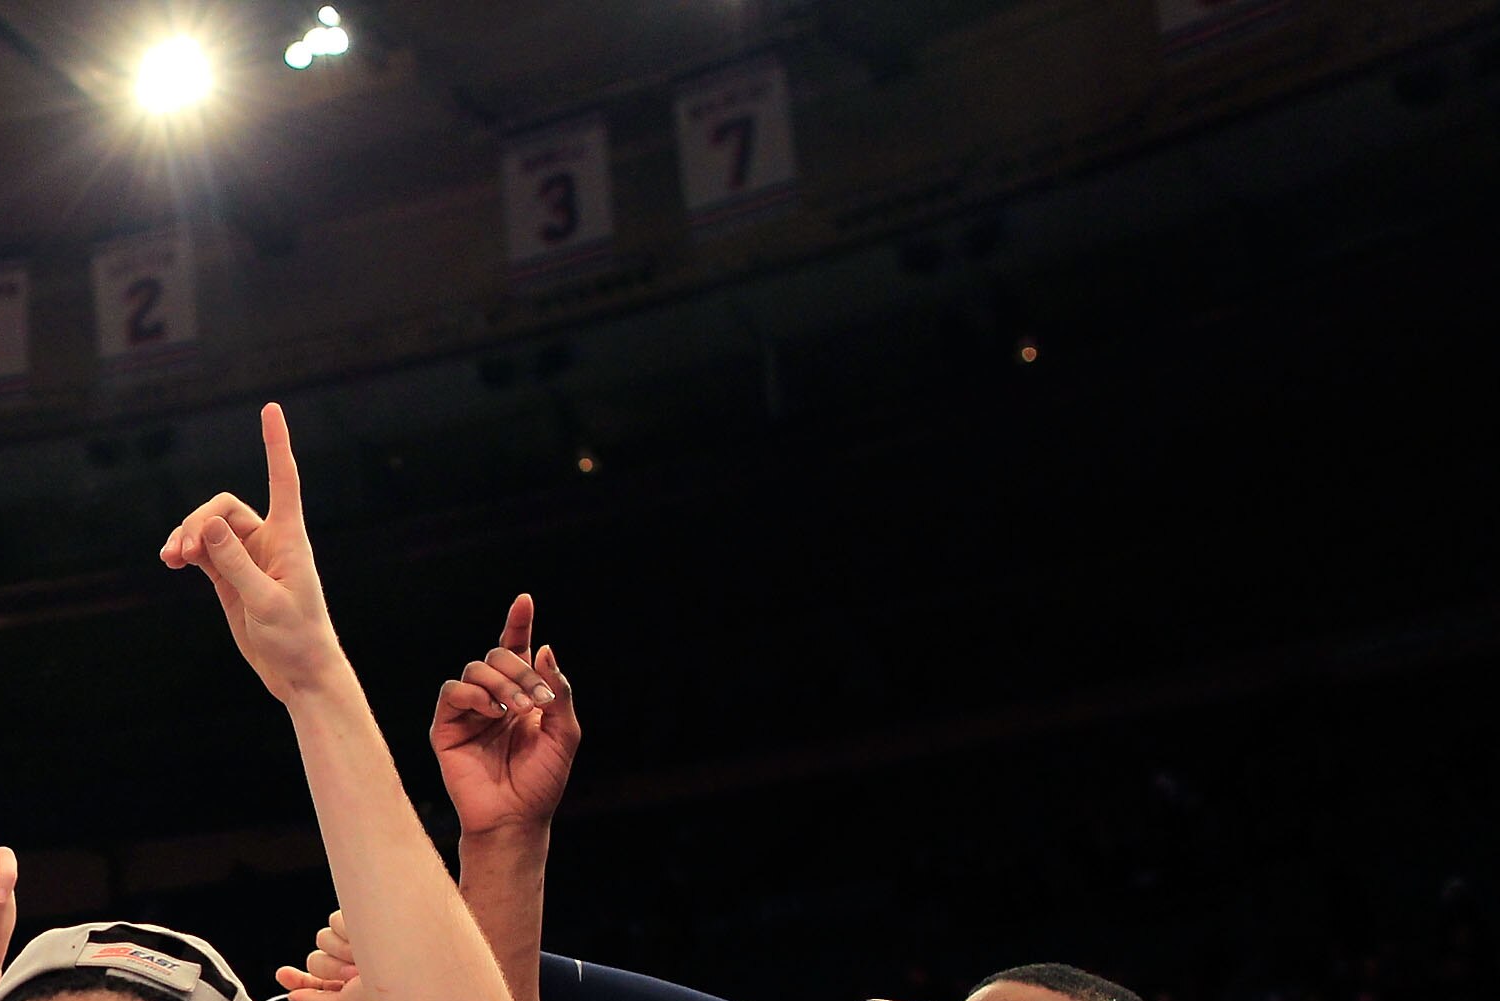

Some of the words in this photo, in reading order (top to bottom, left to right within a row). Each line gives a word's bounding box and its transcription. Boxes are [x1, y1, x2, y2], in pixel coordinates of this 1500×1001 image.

[711, 114, 756, 191] 7
[540, 173, 579, 245] 3
[123, 277, 166, 347] 2
[129, 949, 181, 969] EAST
